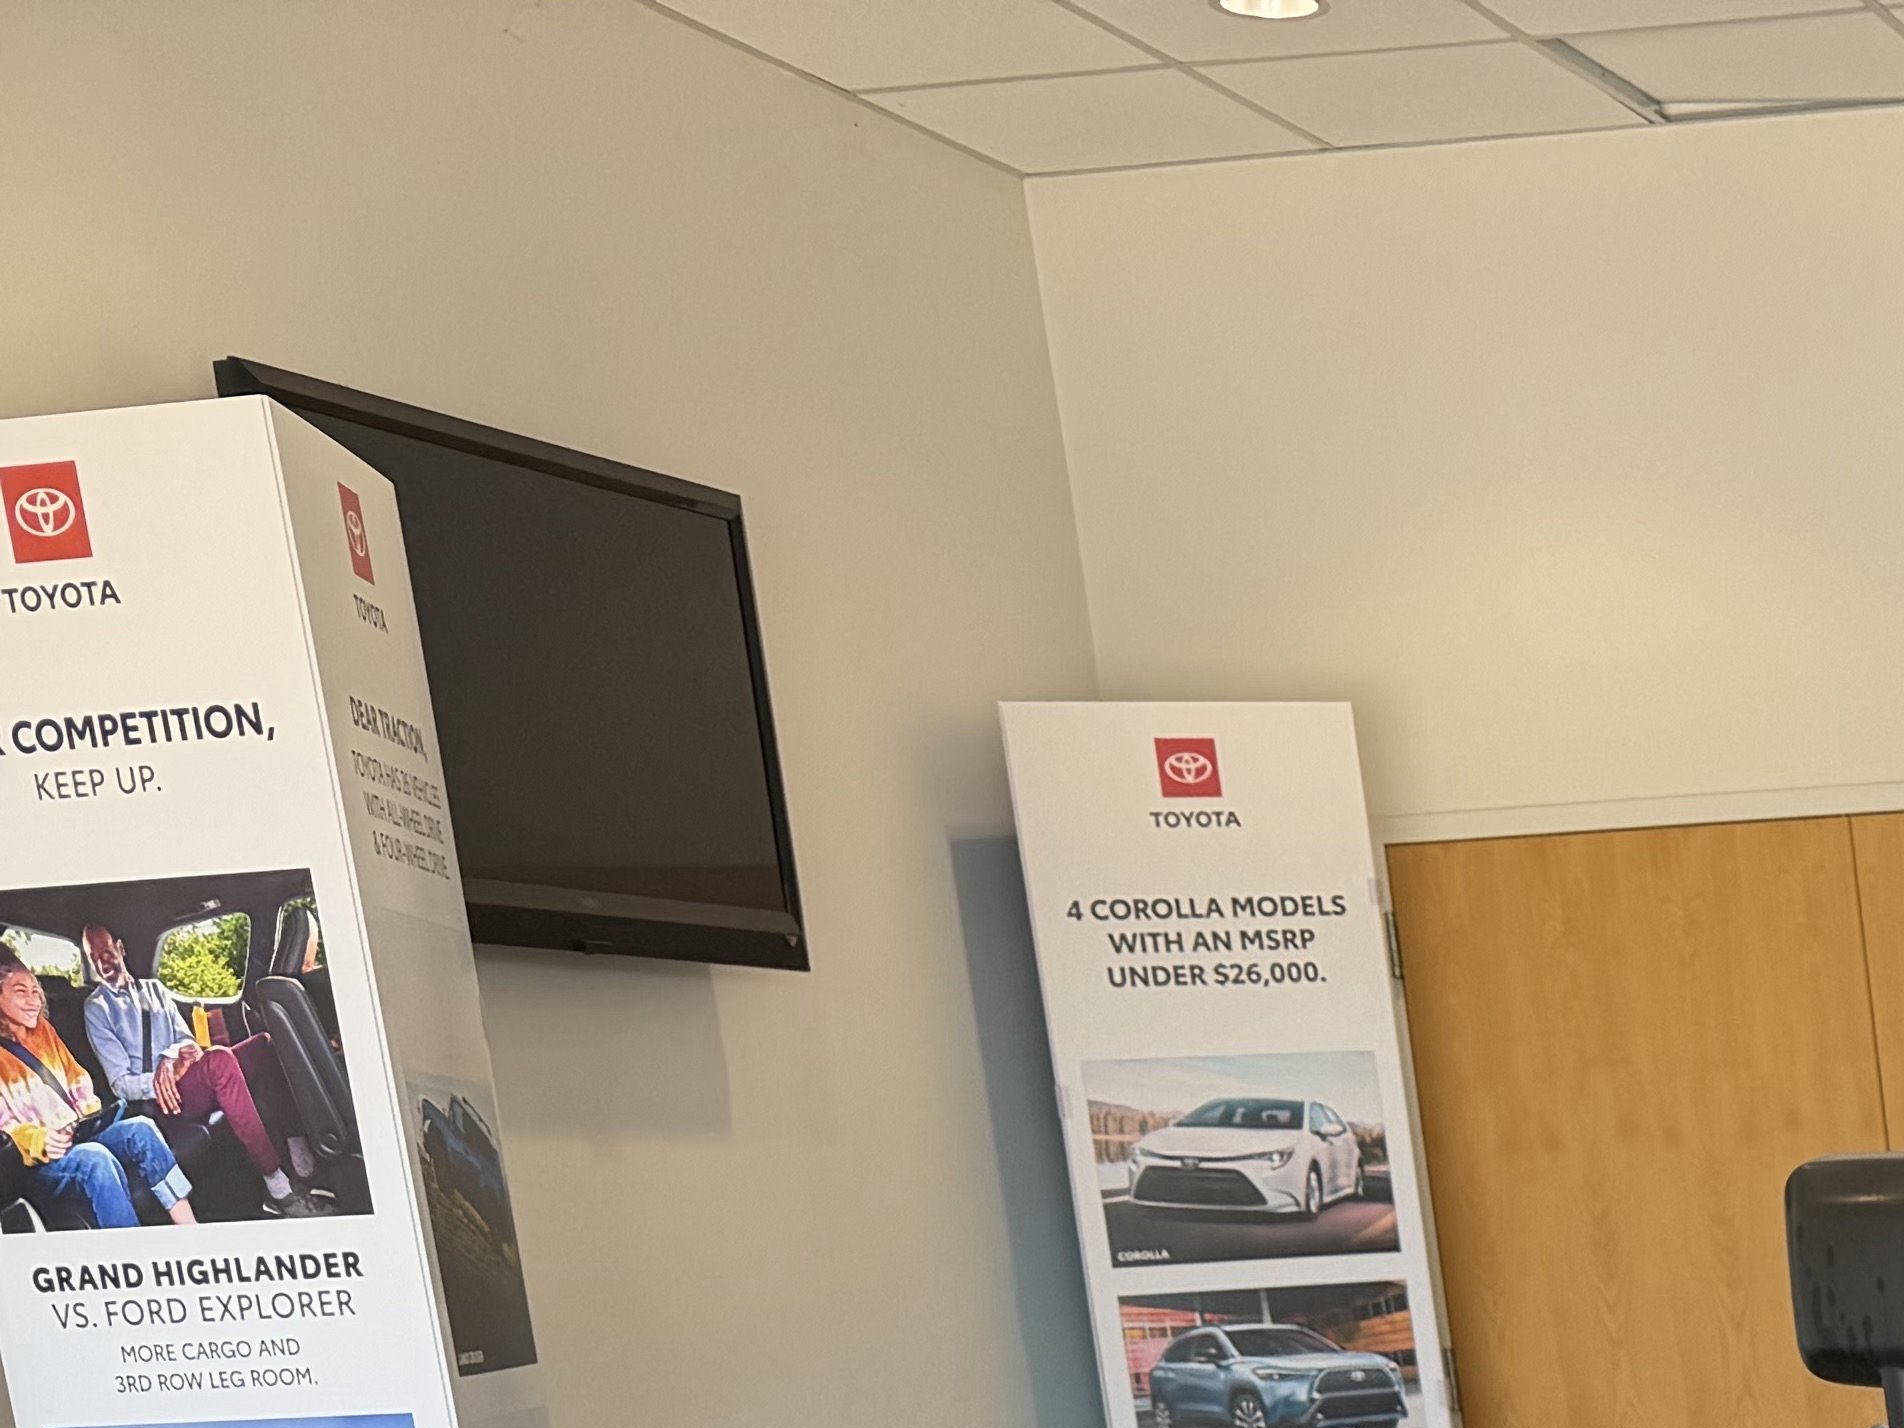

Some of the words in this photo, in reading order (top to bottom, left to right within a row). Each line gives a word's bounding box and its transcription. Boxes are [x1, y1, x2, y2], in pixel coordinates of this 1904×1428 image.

[2, 580, 121, 613] TOYOTA
[353, 594, 389, 634] TOYOTA
[12, 702, 274, 754] COMPETITION,
[349, 695, 380, 736] DEAR
[35, 769, 104, 800] KEEP
[116, 765, 161, 794] UP.
[1149, 811, 1242, 828] TOYOTA
[1066, 900, 1083, 921] 4
[1090, 897, 1225, 921] COROLLA
[1231, 895, 1347, 918] MODELS
[1107, 931, 1184, 954] WITH
[1191, 930, 1232, 952] AN
[1240, 928, 1315, 951] MSRP
[1106, 964, 1208, 988] UNDER
[1213, 961, 1328, 988] $26,000.
[1117, 1248, 1171, 1262] COROLLA
[32, 1263, 144, 1293] GRAND
[152, 1251, 364, 1287] HIGHLANDER
[51, 1302, 98, 1329] VS.
[104, 1298, 187, 1327] FORD
[199, 1290, 357, 1323] EXPLORER
[121, 1344, 176, 1363] MORE
[182, 1341, 251, 1360] CARGO
[258, 1338, 301, 1357] AND
[115, 1374, 152, 1393] 3RD
[157, 1372, 203, 1391] ROW
[208, 1370, 246, 1389] LEG
[250, 1368, 319, 1387] ROOM.
